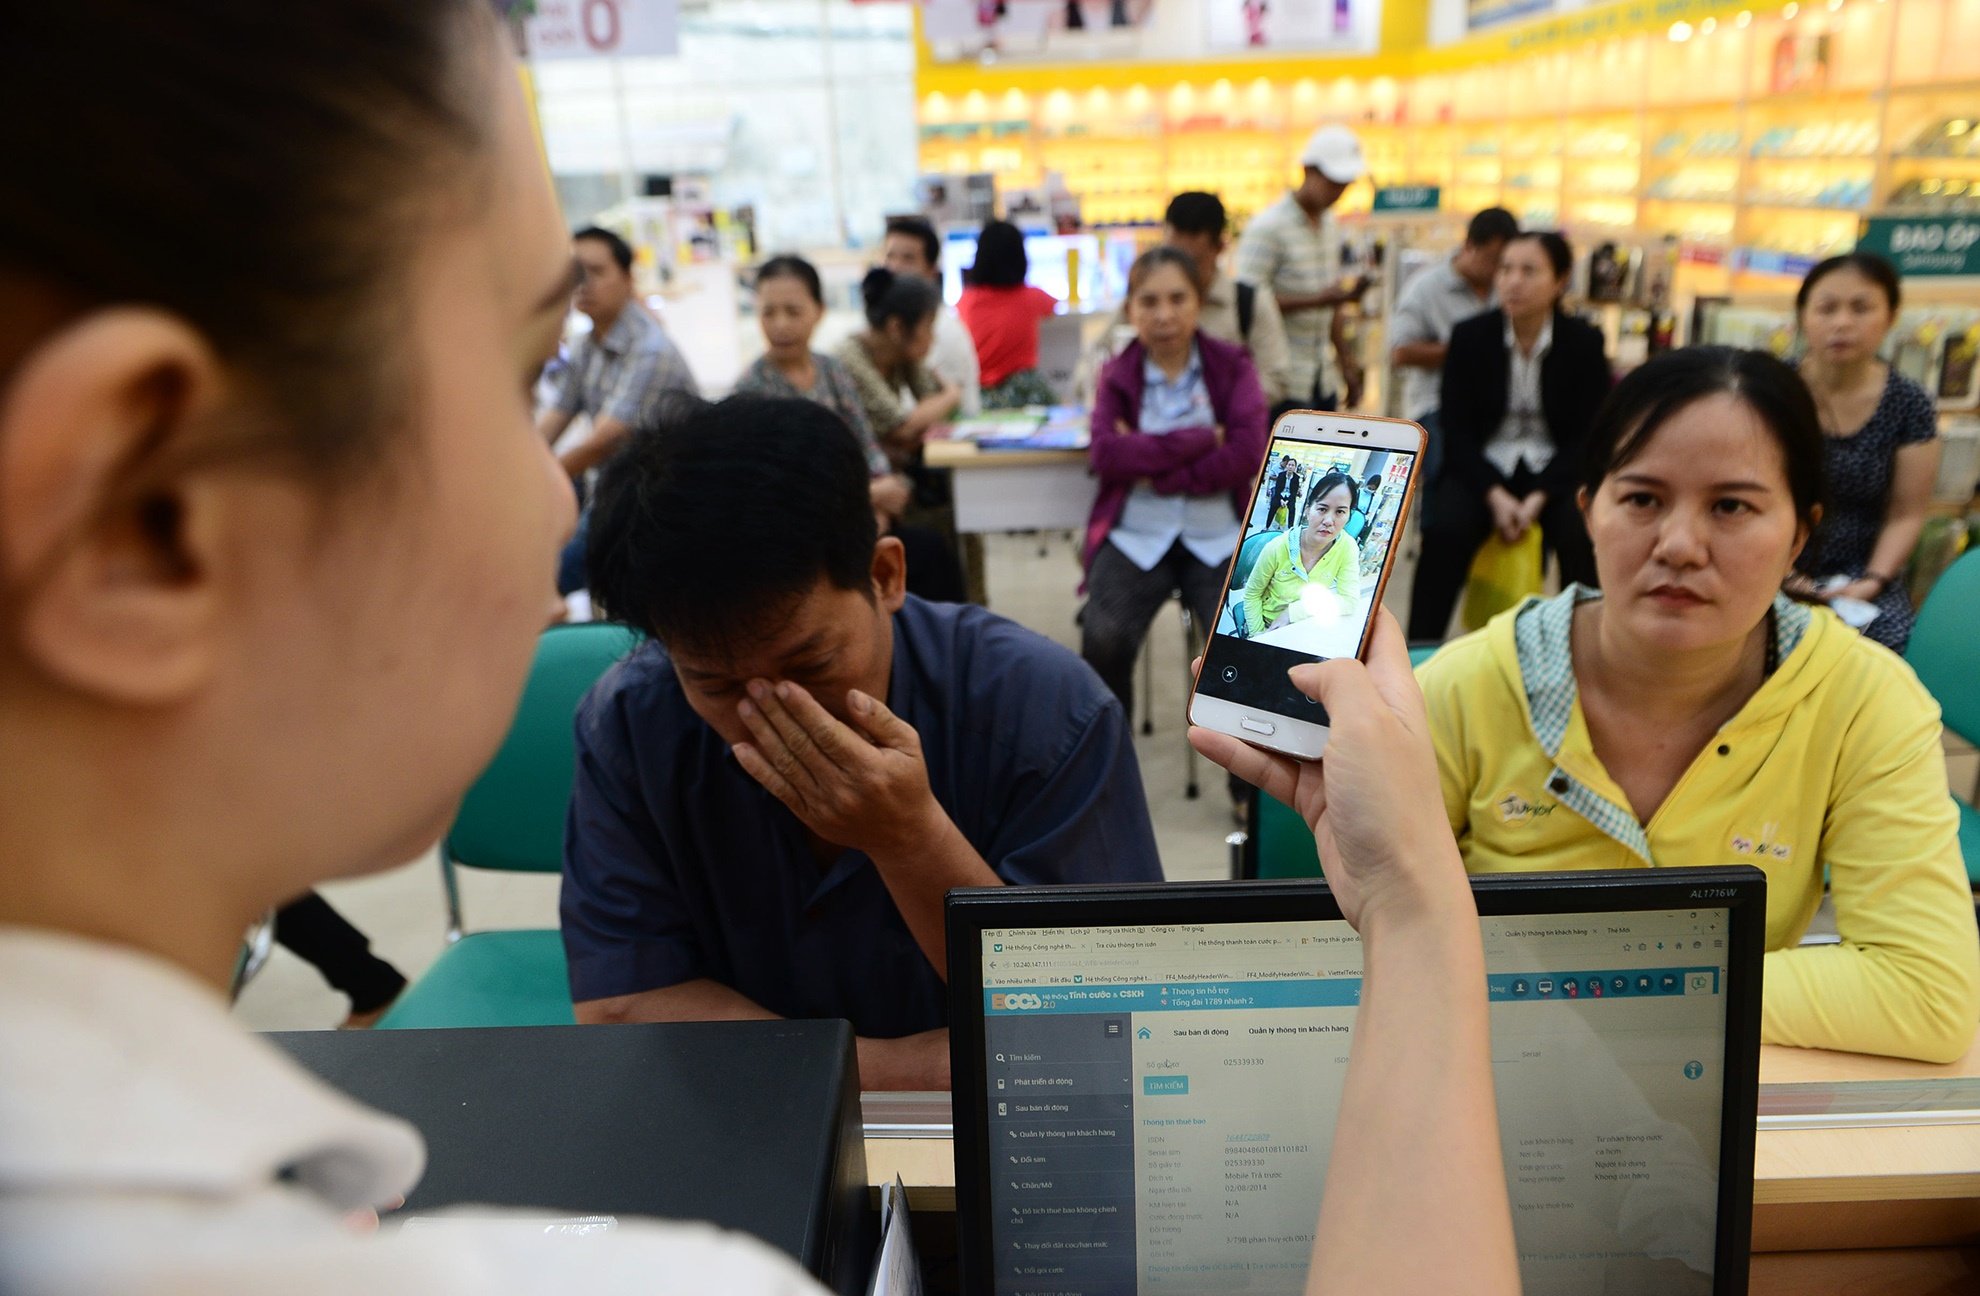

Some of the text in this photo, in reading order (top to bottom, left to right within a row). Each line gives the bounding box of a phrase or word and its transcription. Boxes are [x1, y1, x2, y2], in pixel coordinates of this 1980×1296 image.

[1889, 223, 1944, 253] BAO
[1690, 888, 1738, 898] AL1716W
[1172, 987, 1194, 996] Thông
[1172, 998, 1190, 1007] Tổng
